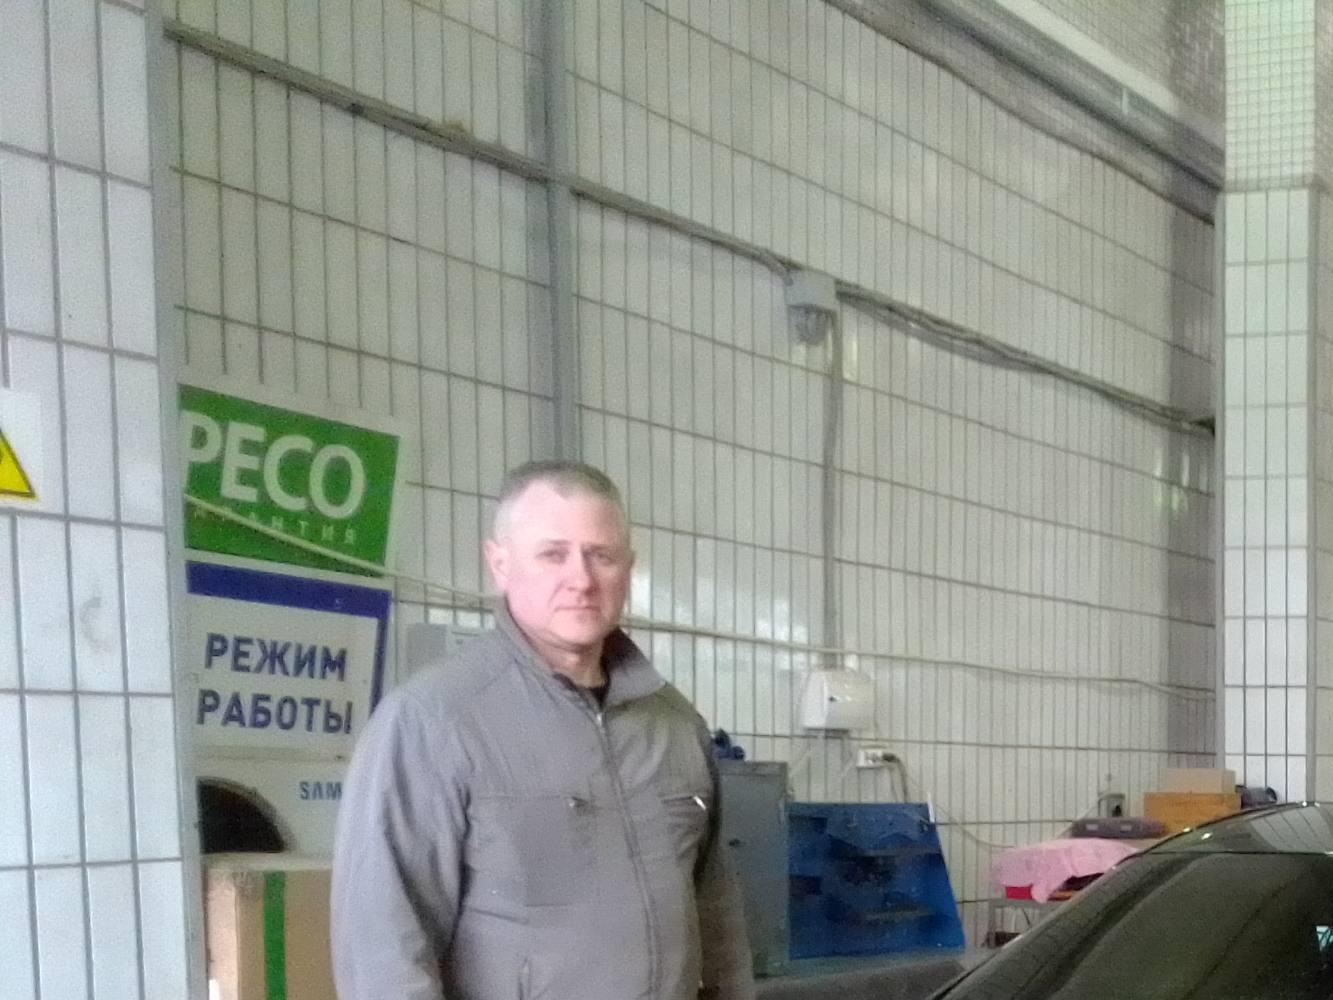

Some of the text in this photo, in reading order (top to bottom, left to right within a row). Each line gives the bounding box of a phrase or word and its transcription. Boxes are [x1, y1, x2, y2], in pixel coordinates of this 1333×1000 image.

[182, 410, 366, 519] РЕСО
[205, 633, 347, 682] РЕЖИМ
[196, 690, 352, 734] РАБОТЫ
[300, 781, 342, 800] SAM
